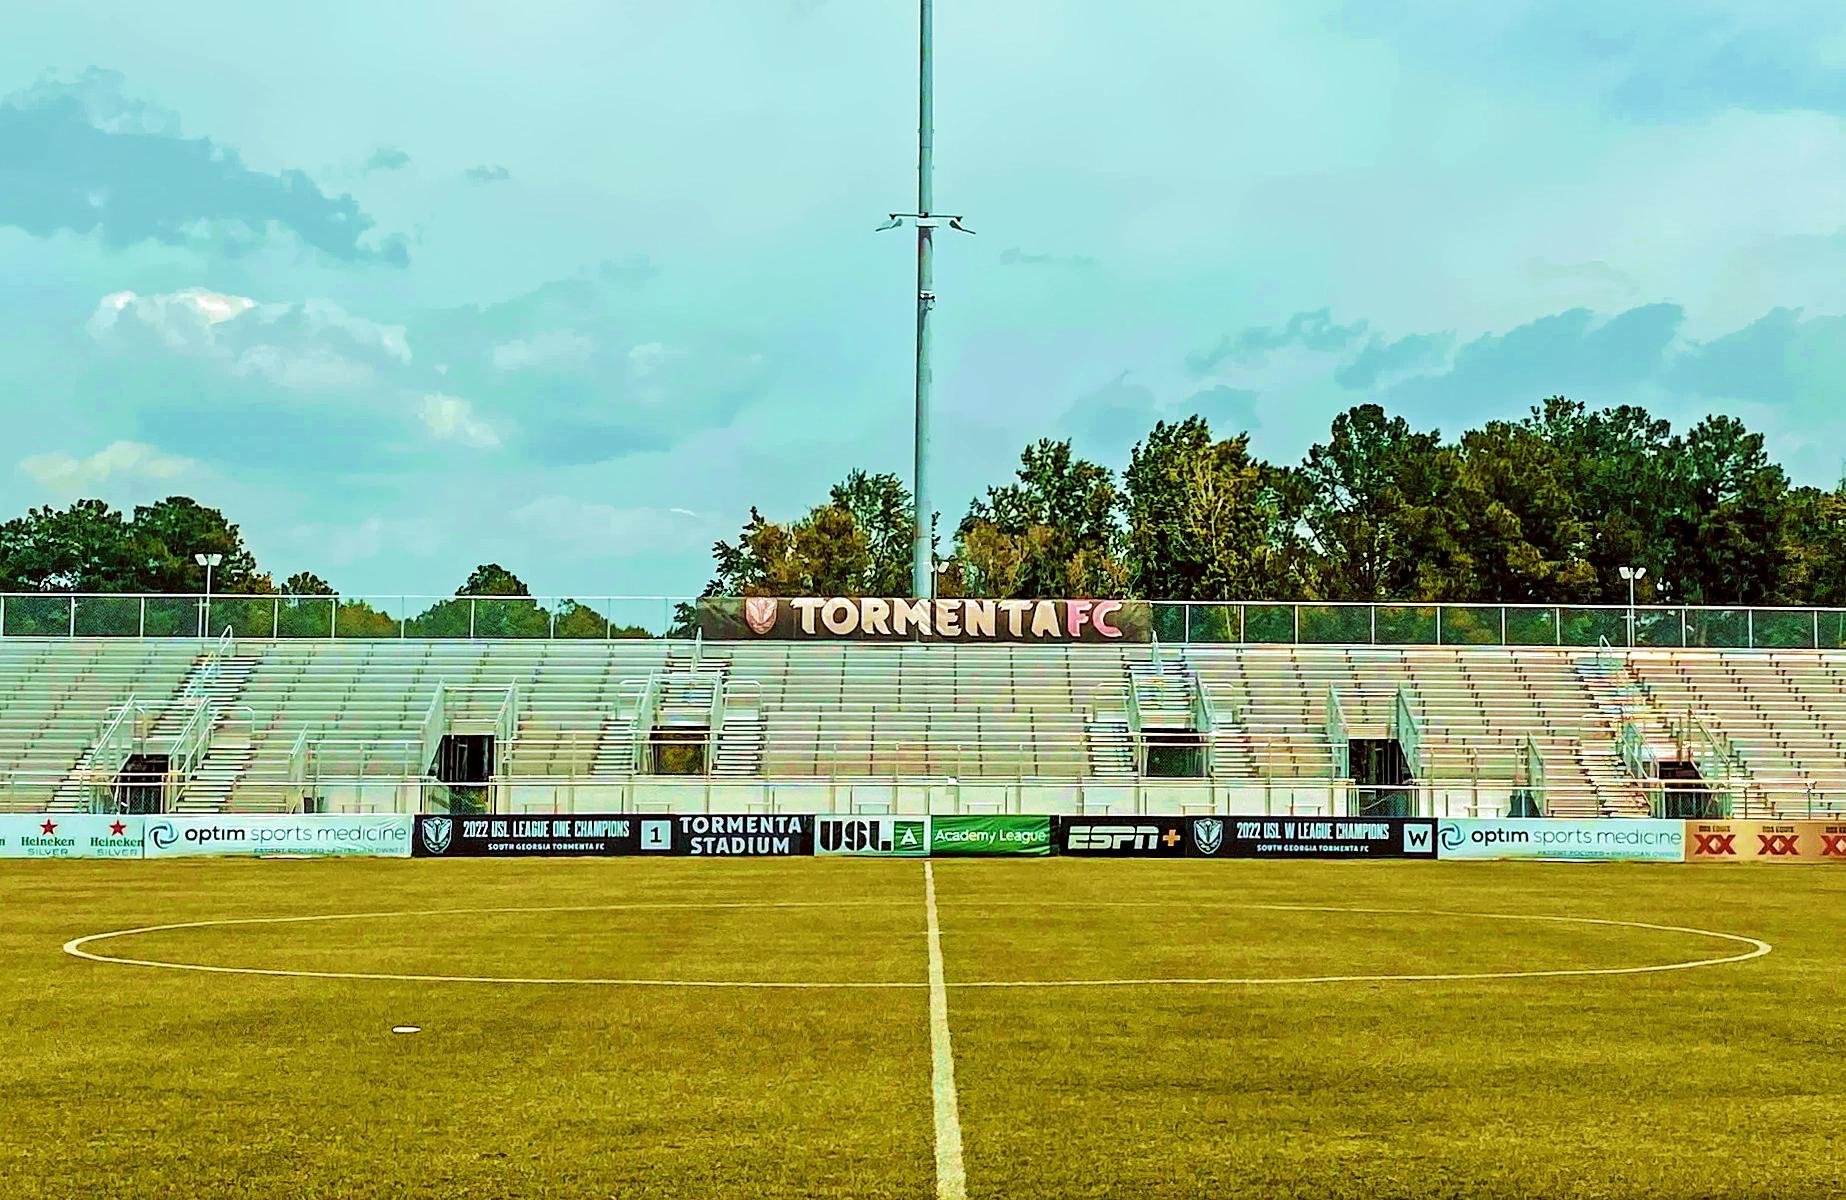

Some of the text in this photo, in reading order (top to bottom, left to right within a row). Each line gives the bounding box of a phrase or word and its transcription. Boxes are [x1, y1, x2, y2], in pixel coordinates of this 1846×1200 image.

[789, 596, 1123, 637] TORMENTA FC
[463, 820, 630, 838] 2022 USL LEAGUE ONE CHAMPIONS
[679, 816, 802, 834] TORMENTA
[1236, 822, 1390, 840] 2022 USL W LEAGUE CHAMPIONS
[21, 836, 75, 847] Heineken
[90, 836, 144, 847] Heineken
[185, 825, 406, 845] optim sports medicine
[650, 826, 662, 843] 1
[820, 820, 891, 851] USL
[900, 827, 918, 845] A
[935, 828, 1047, 844] Academy League
[1408, 830, 1428, 846] W
[1471, 828, 1529, 846] optim
[1533, 828, 1592, 845] sports
[1597, 828, 1682, 845] medicine
[28, 848, 68, 856] SILVER
[97, 848, 138, 856] SILVER
[690, 837, 789, 854] STADIUM
[1256, 844, 1369, 852] SOUTH GEORGIA TORMENTA FC
[1693, 834, 1736, 855] XX
[1757, 834, 1799, 855] XX
